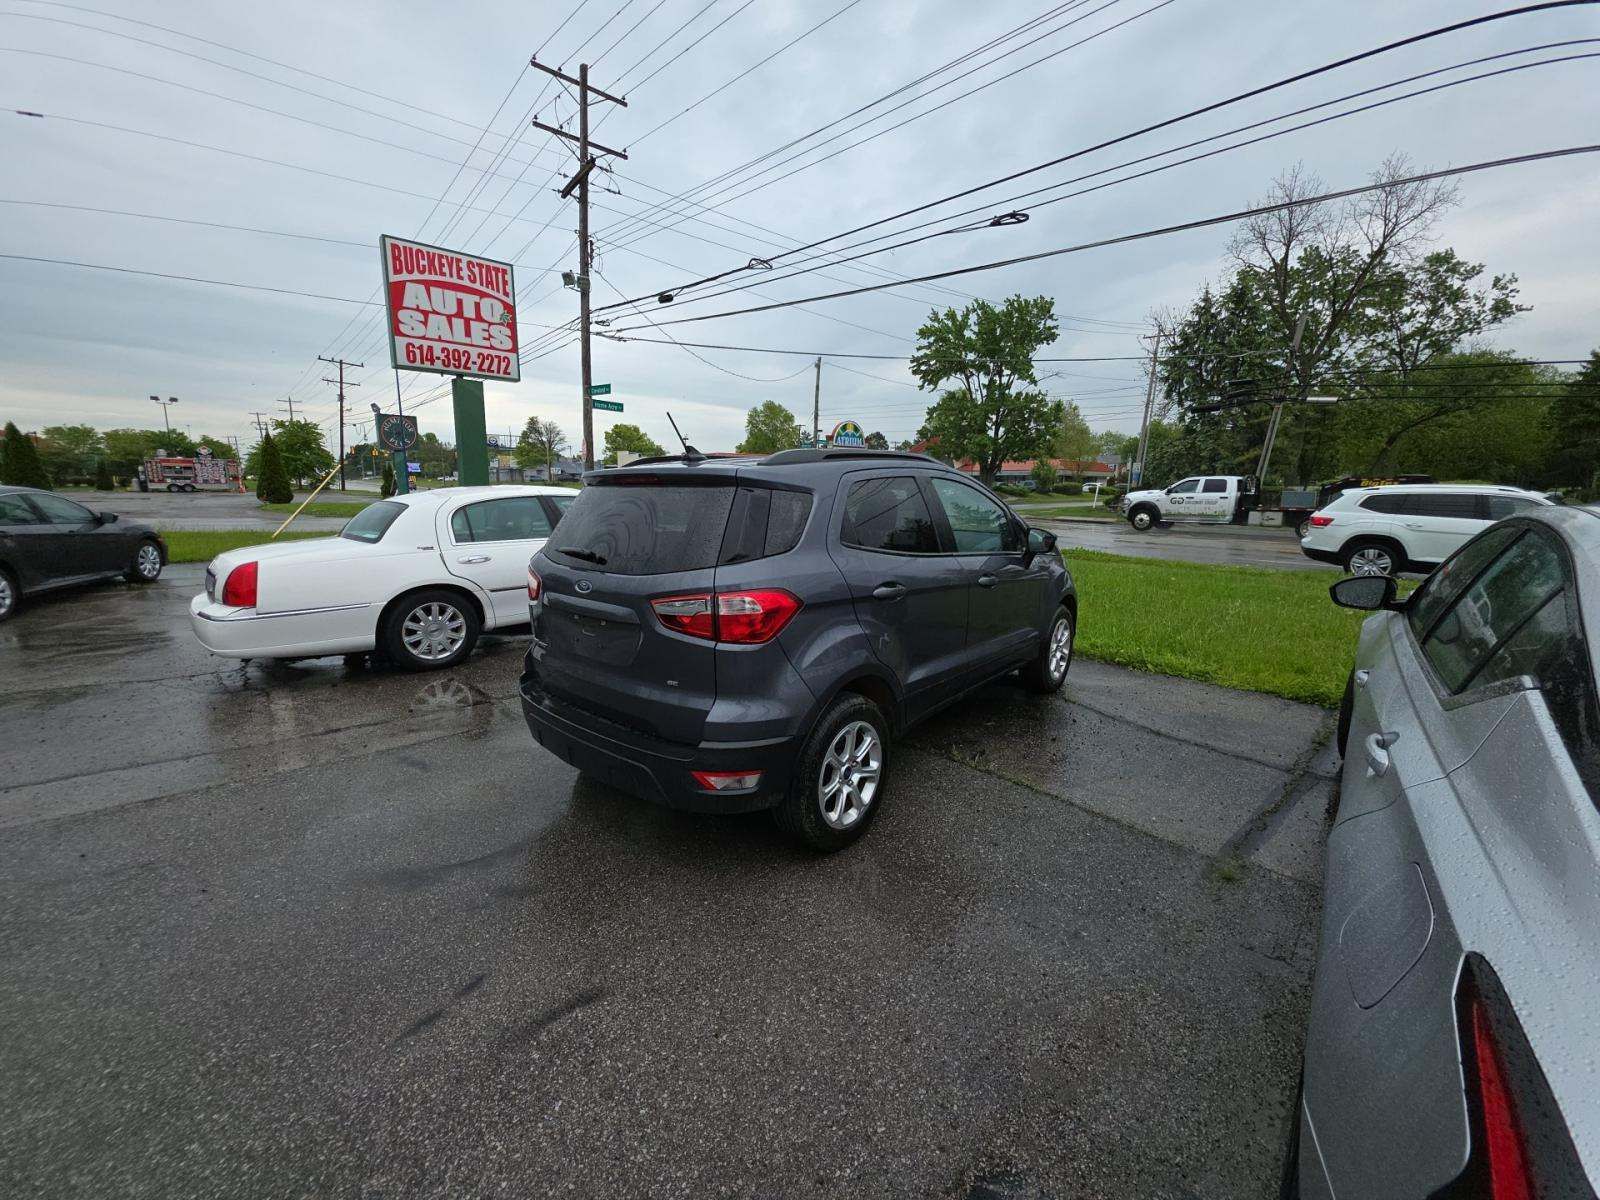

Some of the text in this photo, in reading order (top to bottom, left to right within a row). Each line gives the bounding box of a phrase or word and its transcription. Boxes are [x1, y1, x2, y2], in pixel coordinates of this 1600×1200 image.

[390, 243, 510, 298] BUCKEYE STATE
[402, 282, 504, 324] AUTO
[397, 309, 513, 350] SALES
[405, 342, 511, 376] 614-392-2272
